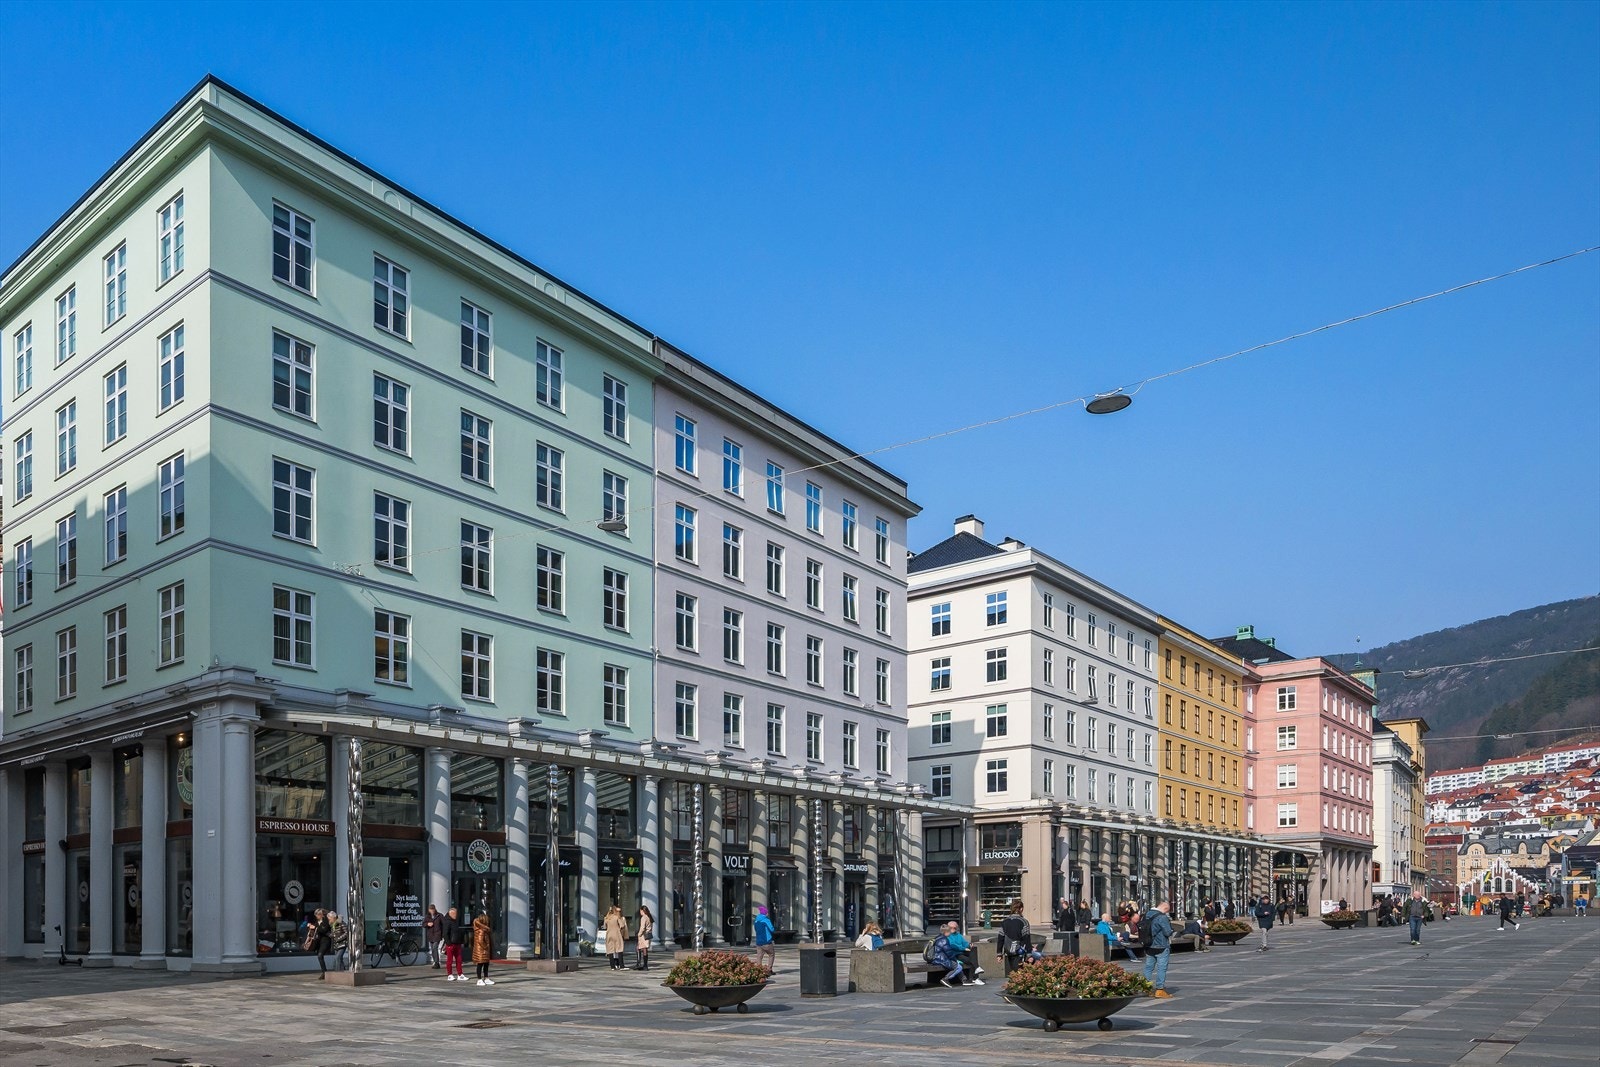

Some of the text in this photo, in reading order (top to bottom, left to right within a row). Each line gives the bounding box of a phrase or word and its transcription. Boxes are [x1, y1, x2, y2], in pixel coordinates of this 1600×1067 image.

[260, 821, 330, 832] ESPRESSO HOUSE
[984, 851, 1020, 859] EUROSKO
[724, 855, 749, 868] VOLT
[844, 863, 868, 871] CARLINGS
